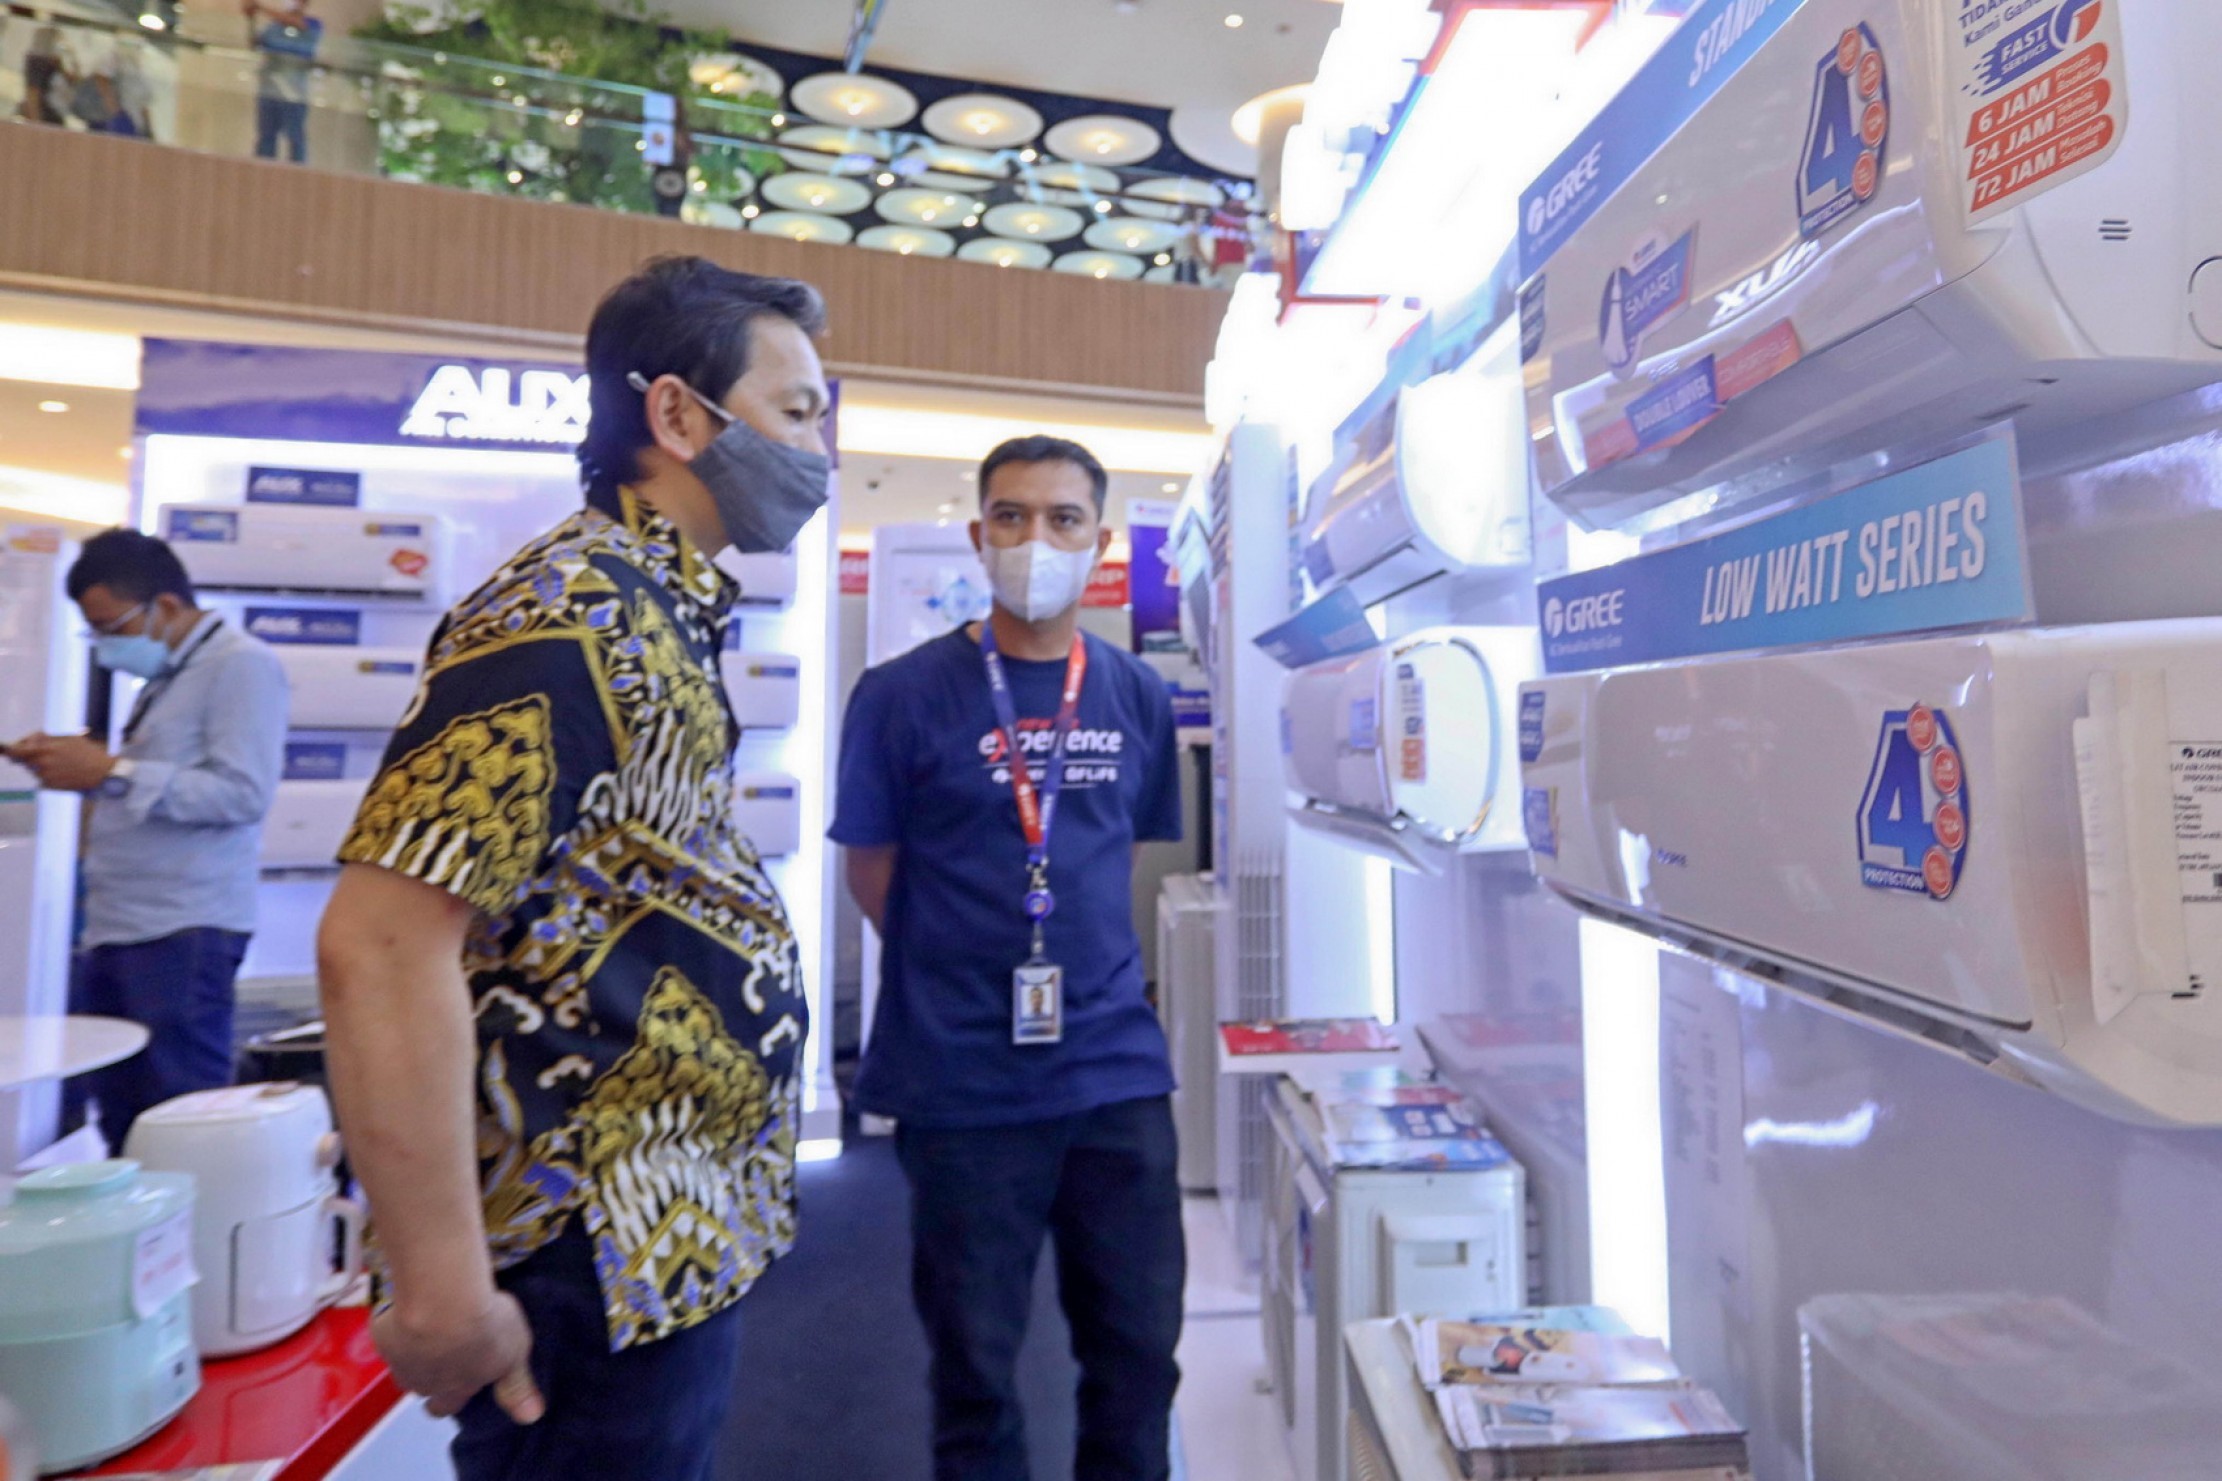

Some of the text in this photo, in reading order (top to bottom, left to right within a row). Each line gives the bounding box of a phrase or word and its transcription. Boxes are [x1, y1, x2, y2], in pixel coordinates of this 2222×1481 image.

[1958, 0, 2007, 29] TIDA
[2004, 0, 2042, 21] Gan
[1689, 0, 1775, 88] STAN
[2000, 21, 2048, 62] FAST
[2001, 40, 2048, 74] SERVICE
[1978, 77, 2051, 133] 6 JAM
[1973, 110, 2056, 169] 24 JAM
[1546, 141, 1603, 219] GREE
[1977, 146, 2057, 202] 72 JAM
[1624, 262, 1679, 321] SMART
[405, 365, 592, 424] AUX
[1565, 491, 1987, 633] GREE LOW WATT SERIES
[1863, 867, 1926, 890] PROTECTION
